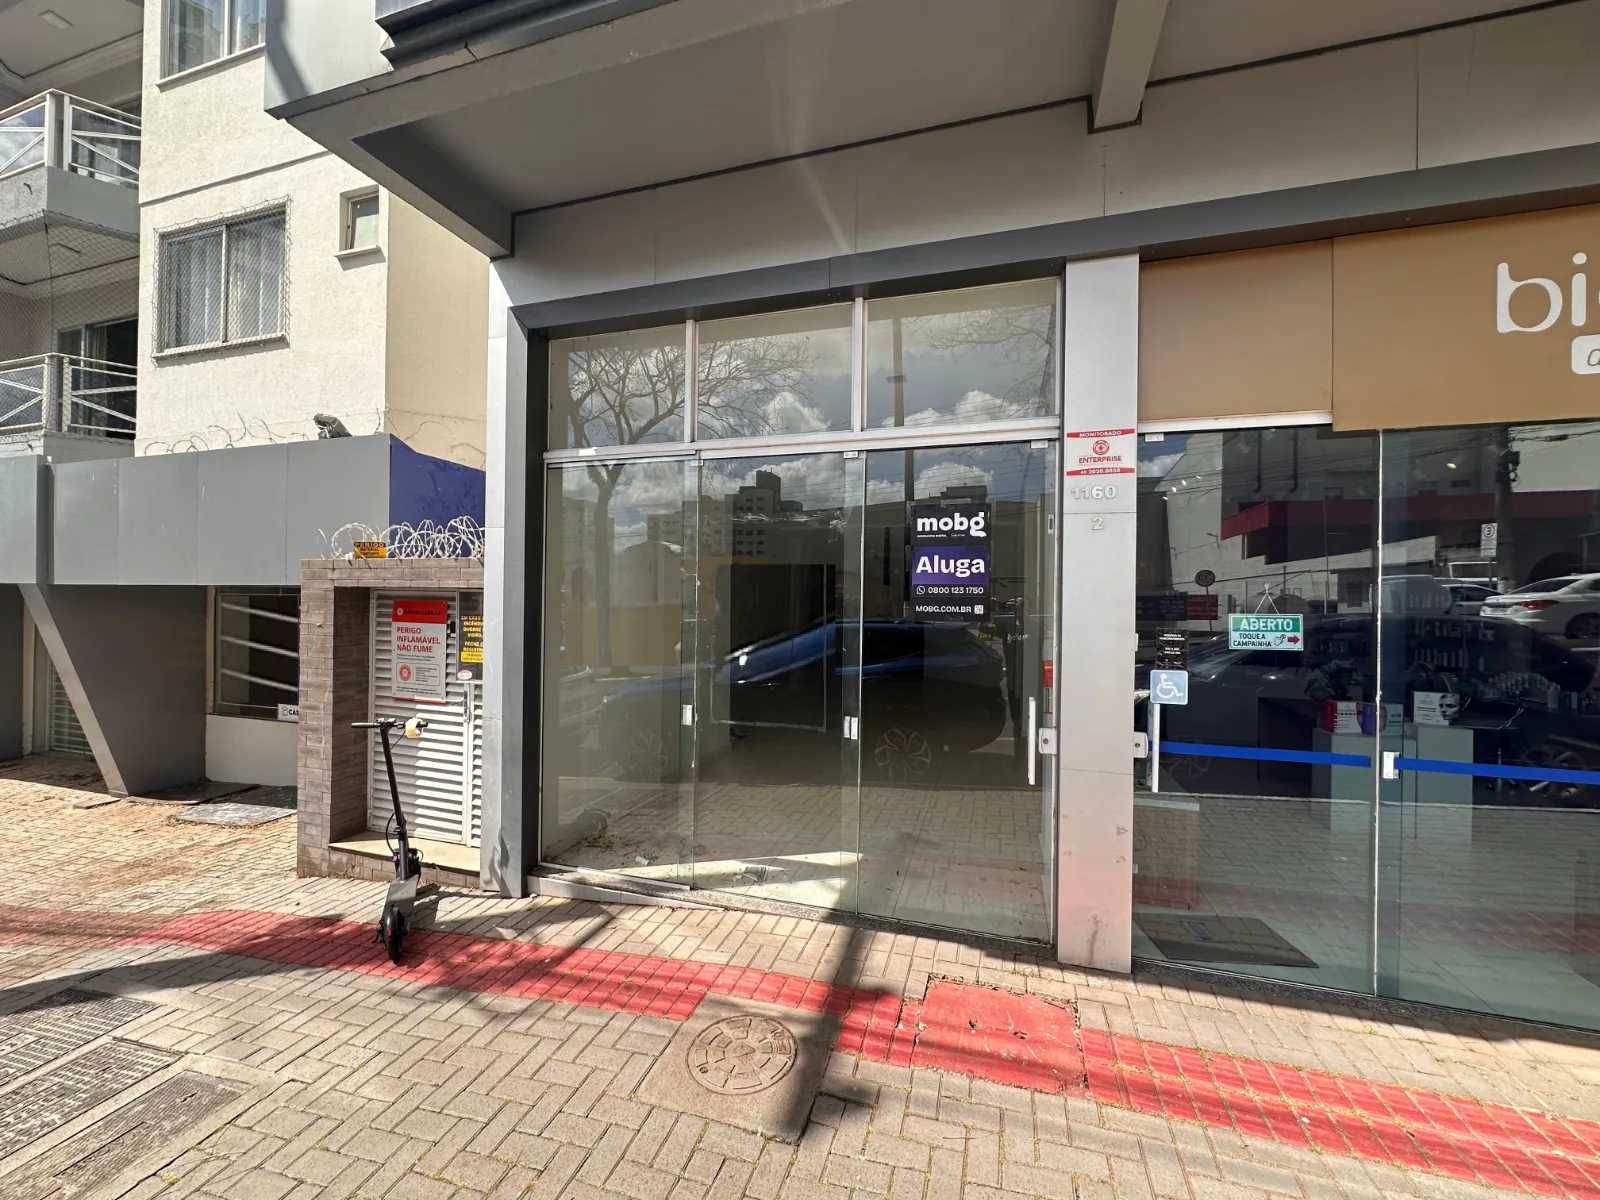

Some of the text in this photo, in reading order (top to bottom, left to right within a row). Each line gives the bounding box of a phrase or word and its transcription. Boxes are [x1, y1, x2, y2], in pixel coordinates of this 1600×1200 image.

[1497, 252, 1600, 334] bi
[1079, 430, 1122, 438] MONITORADO
[1079, 455, 1123, 464] ENTERPRISE
[1070, 485, 1117, 500] 1160
[916, 511, 987, 538] mobg
[1091, 517, 1104, 530] 2
[915, 554, 985, 578] Aluga
[927, 586, 950, 594] 0800
[950, 586, 964, 594] 123
[915, 605, 972, 613] MOBG.COM.BR
[396, 626, 422, 634] PERIGO
[1239, 618, 1293, 631] ABERTO
[396, 643, 433, 653] NÃO FUME
